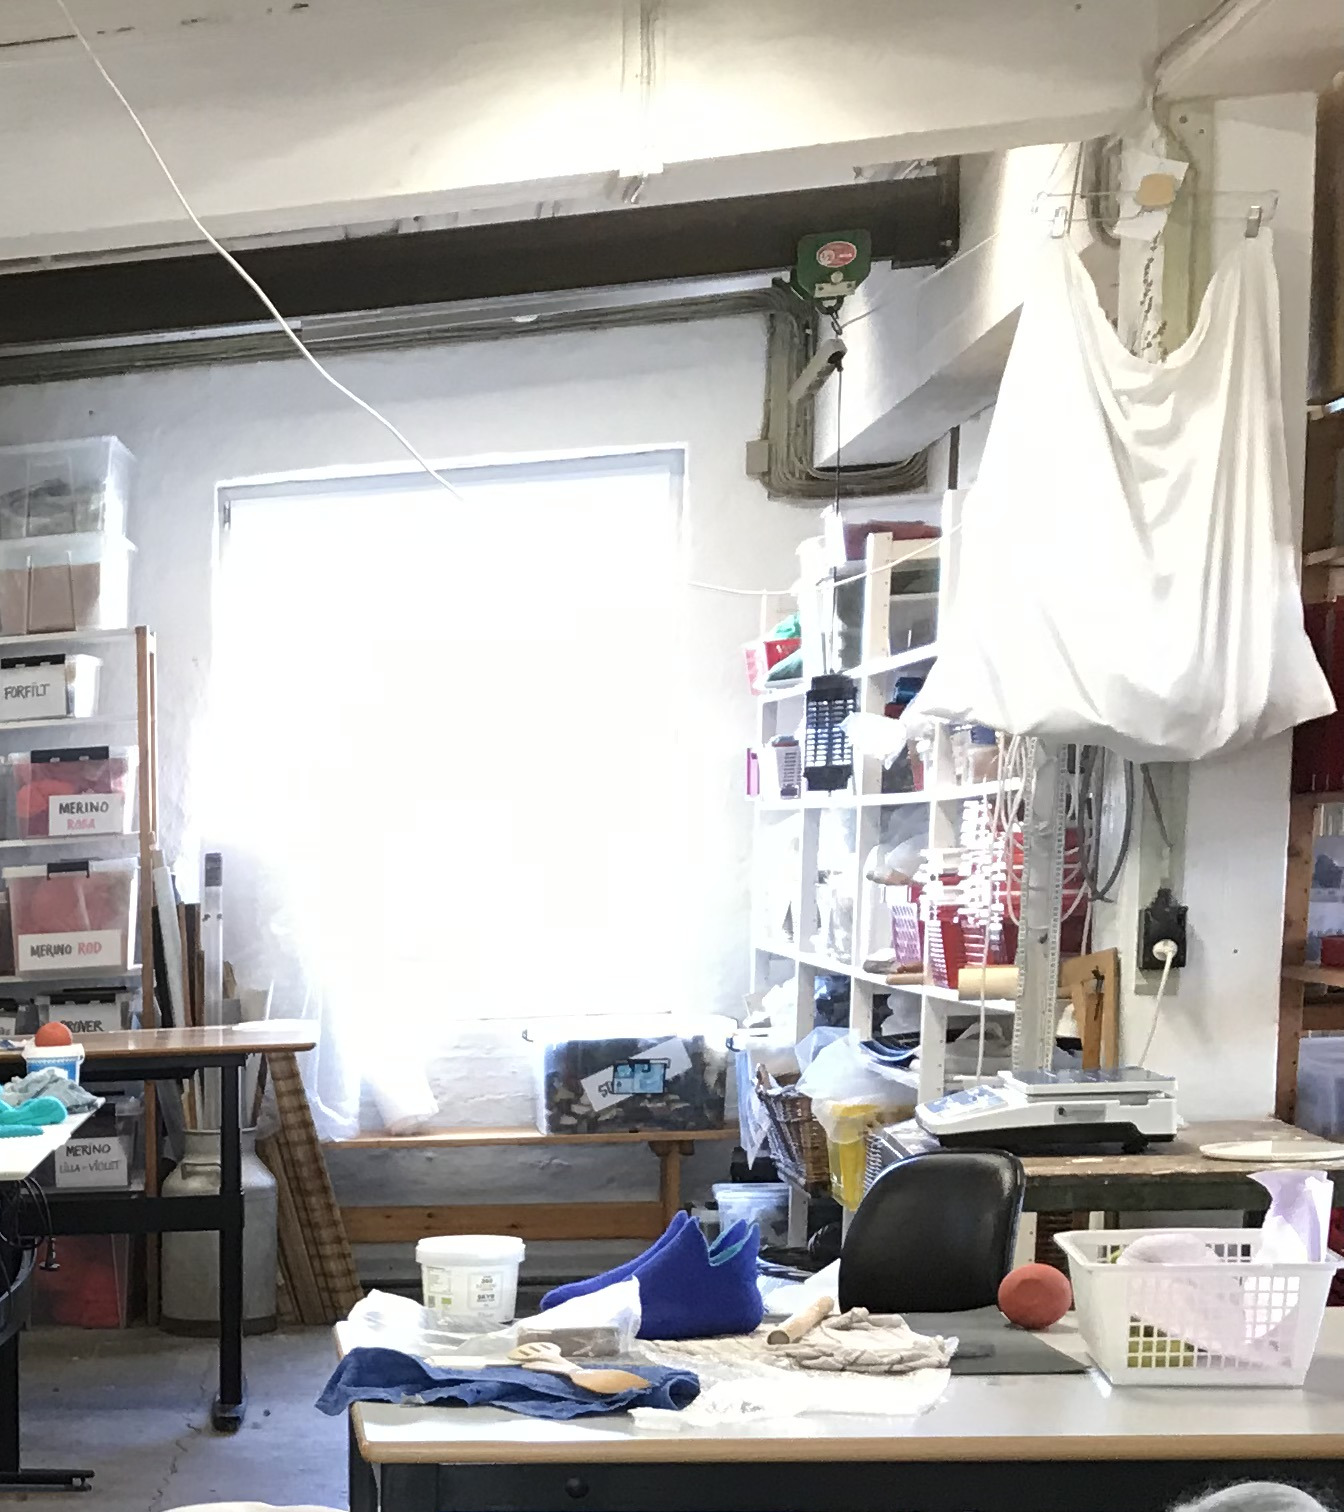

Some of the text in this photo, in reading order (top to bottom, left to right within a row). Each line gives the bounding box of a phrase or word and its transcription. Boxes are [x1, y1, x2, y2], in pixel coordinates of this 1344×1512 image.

[59, 801, 109, 815] MERINO
[30, 943, 72, 958] MERINO
[65, 1143, 111, 1157] MERINO
